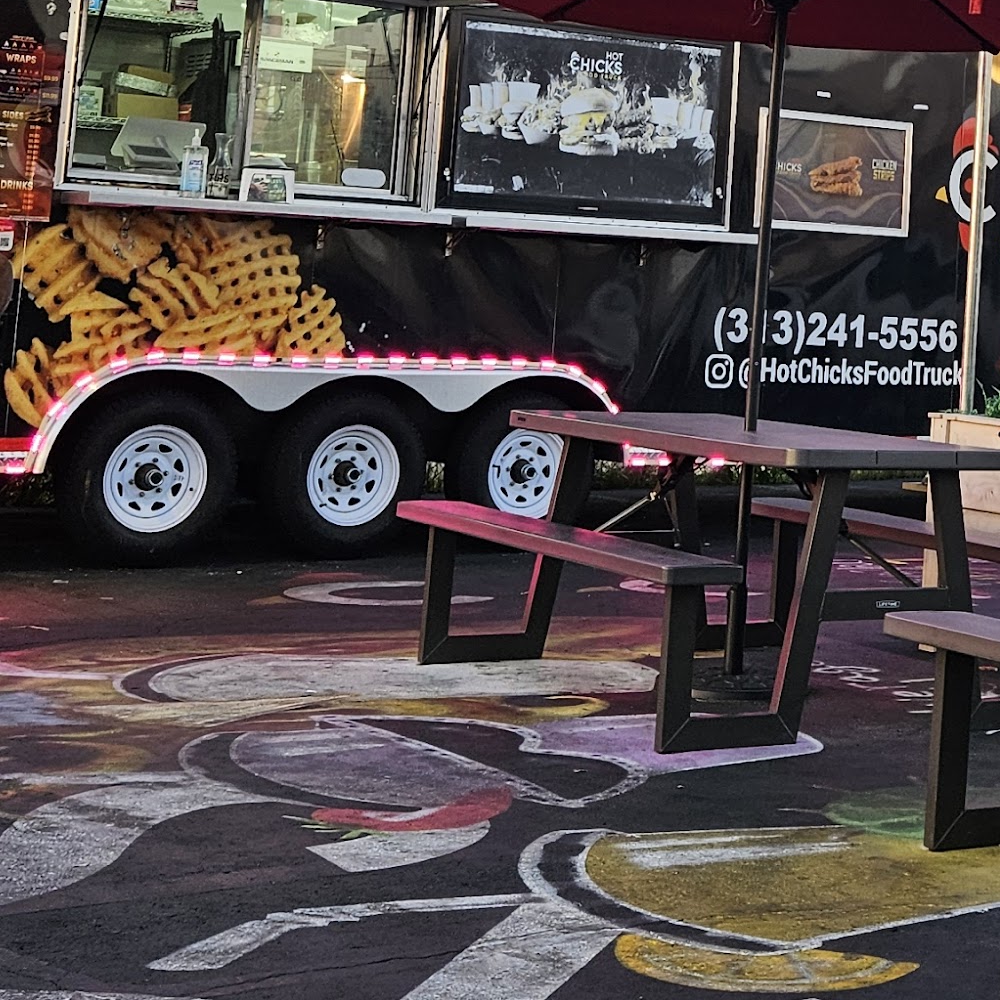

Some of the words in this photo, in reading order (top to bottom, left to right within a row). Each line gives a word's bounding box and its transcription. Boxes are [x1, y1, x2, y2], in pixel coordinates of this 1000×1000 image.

[6, 53, 37, 64] WRAPS
[605, 51, 624, 61] HOT
[570, 57, 623, 75] CHICKS
[2, 110, 24, 120] SIDES
[776, 161, 802, 172] HICKS
[872, 170, 895, 181] STRIPS
[0, 180, 34, 191] DRINKS
